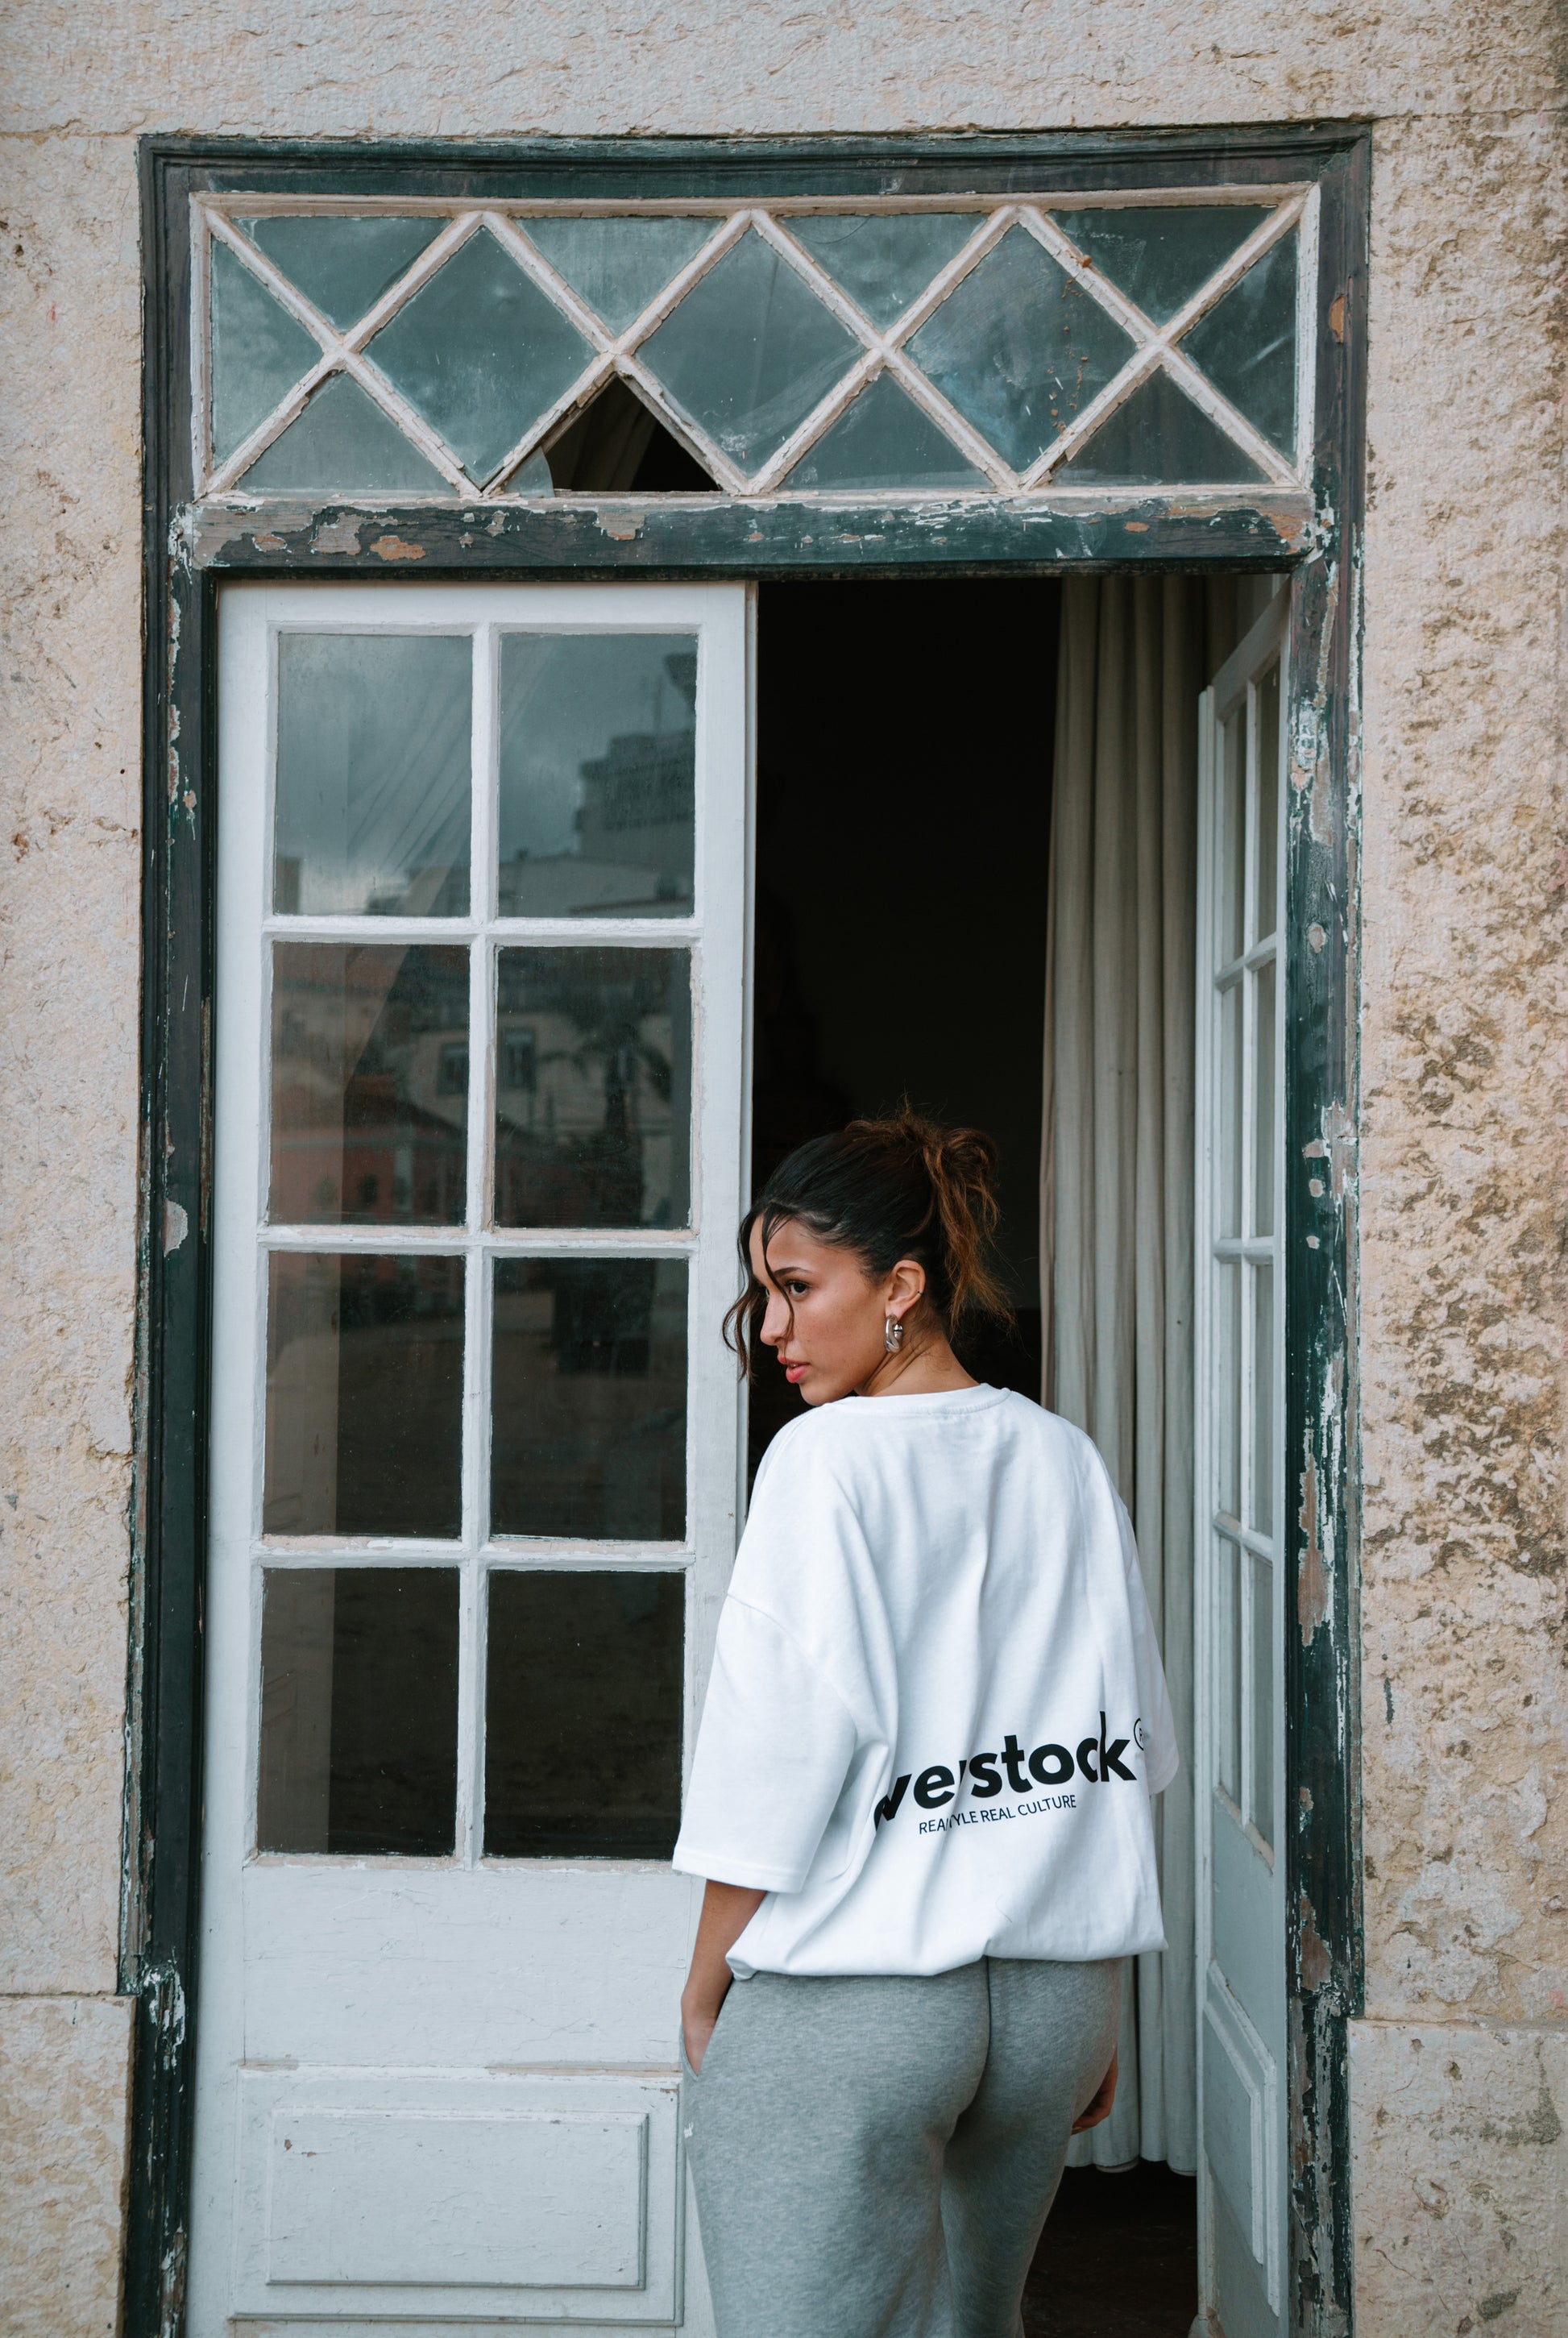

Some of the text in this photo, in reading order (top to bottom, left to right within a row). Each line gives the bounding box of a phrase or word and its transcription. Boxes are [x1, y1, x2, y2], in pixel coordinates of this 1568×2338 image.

[873, 1710, 1137, 1832] vestock
[980, 1807, 1016, 1823] REAL
[1018, 1795, 1077, 1816] CULTURE
